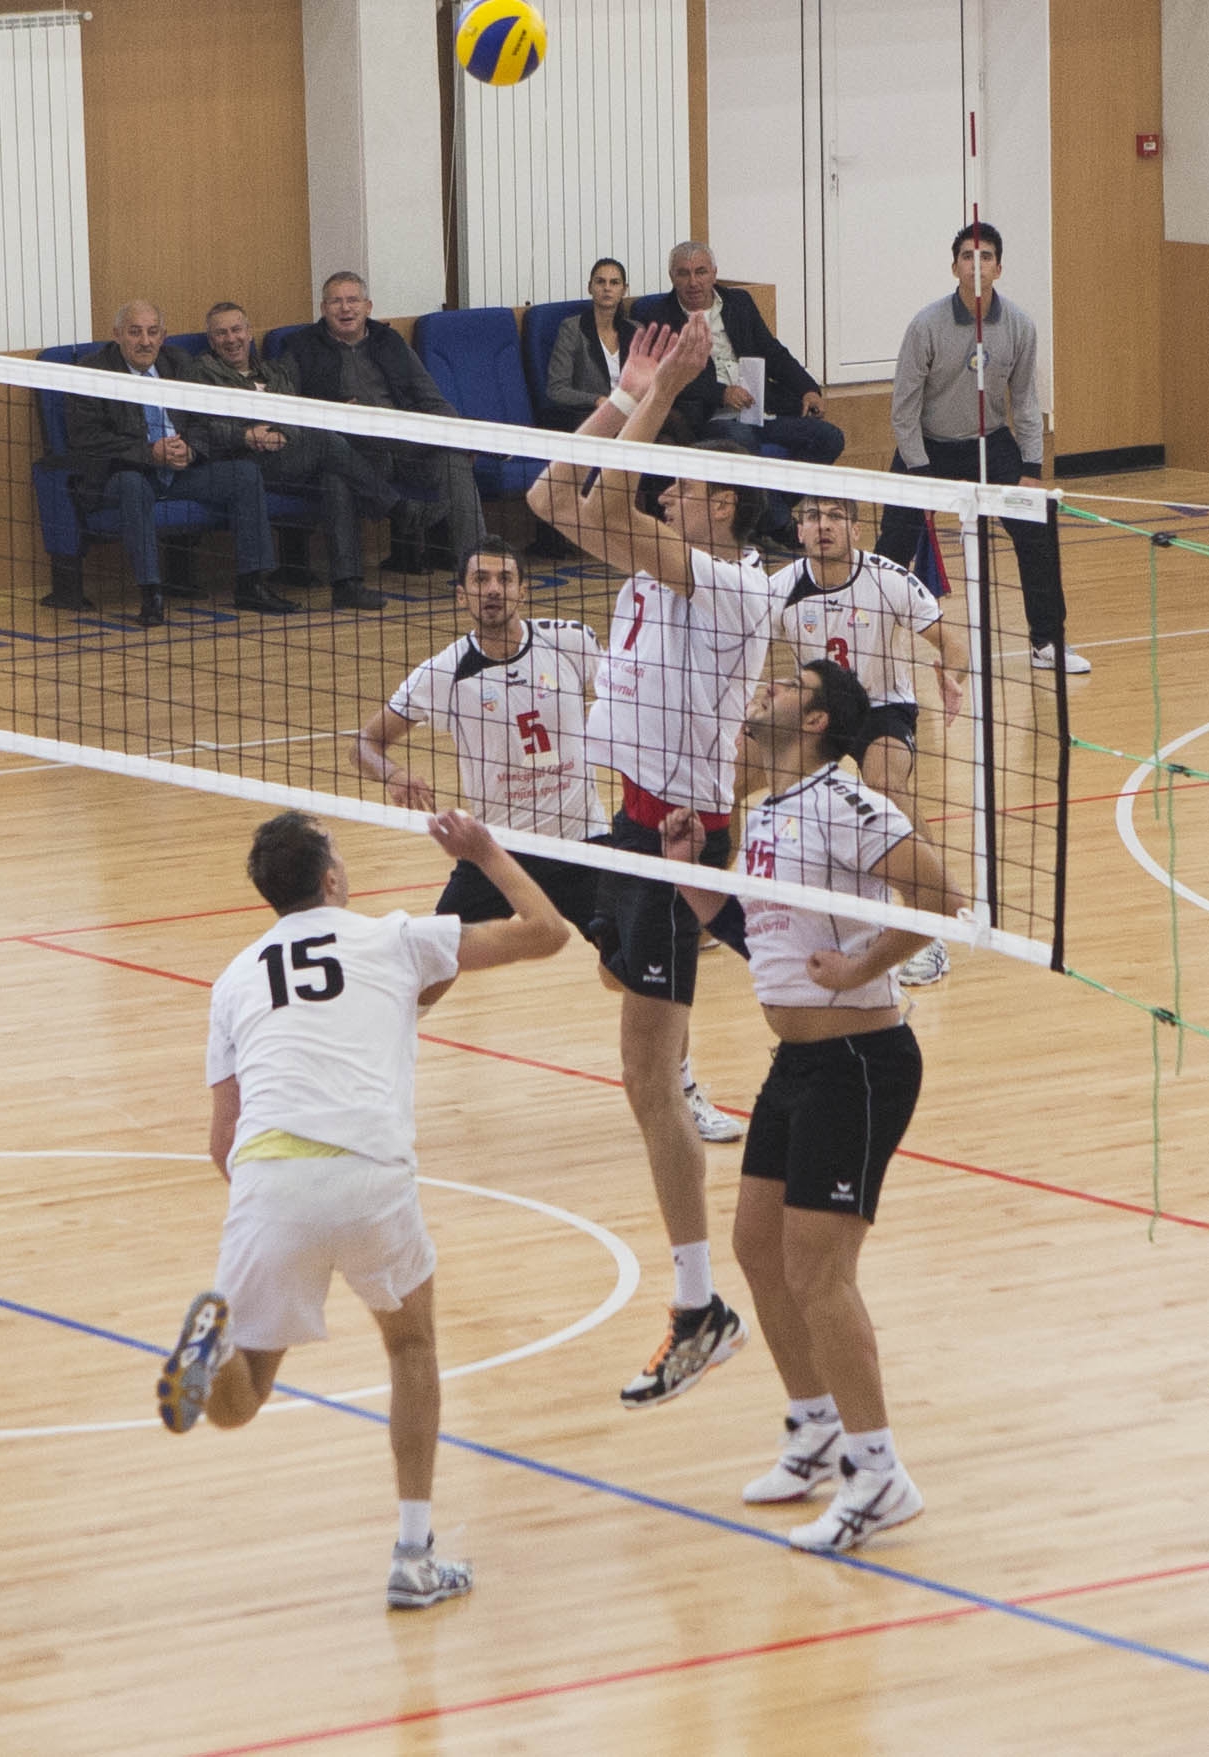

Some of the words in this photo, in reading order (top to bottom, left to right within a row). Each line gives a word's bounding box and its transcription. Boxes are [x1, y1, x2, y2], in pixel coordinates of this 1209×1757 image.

[623, 592, 645, 651] 7
[826, 637, 849, 671] 3
[516, 710, 551, 755] 5
[257, 932, 345, 1010] 15
